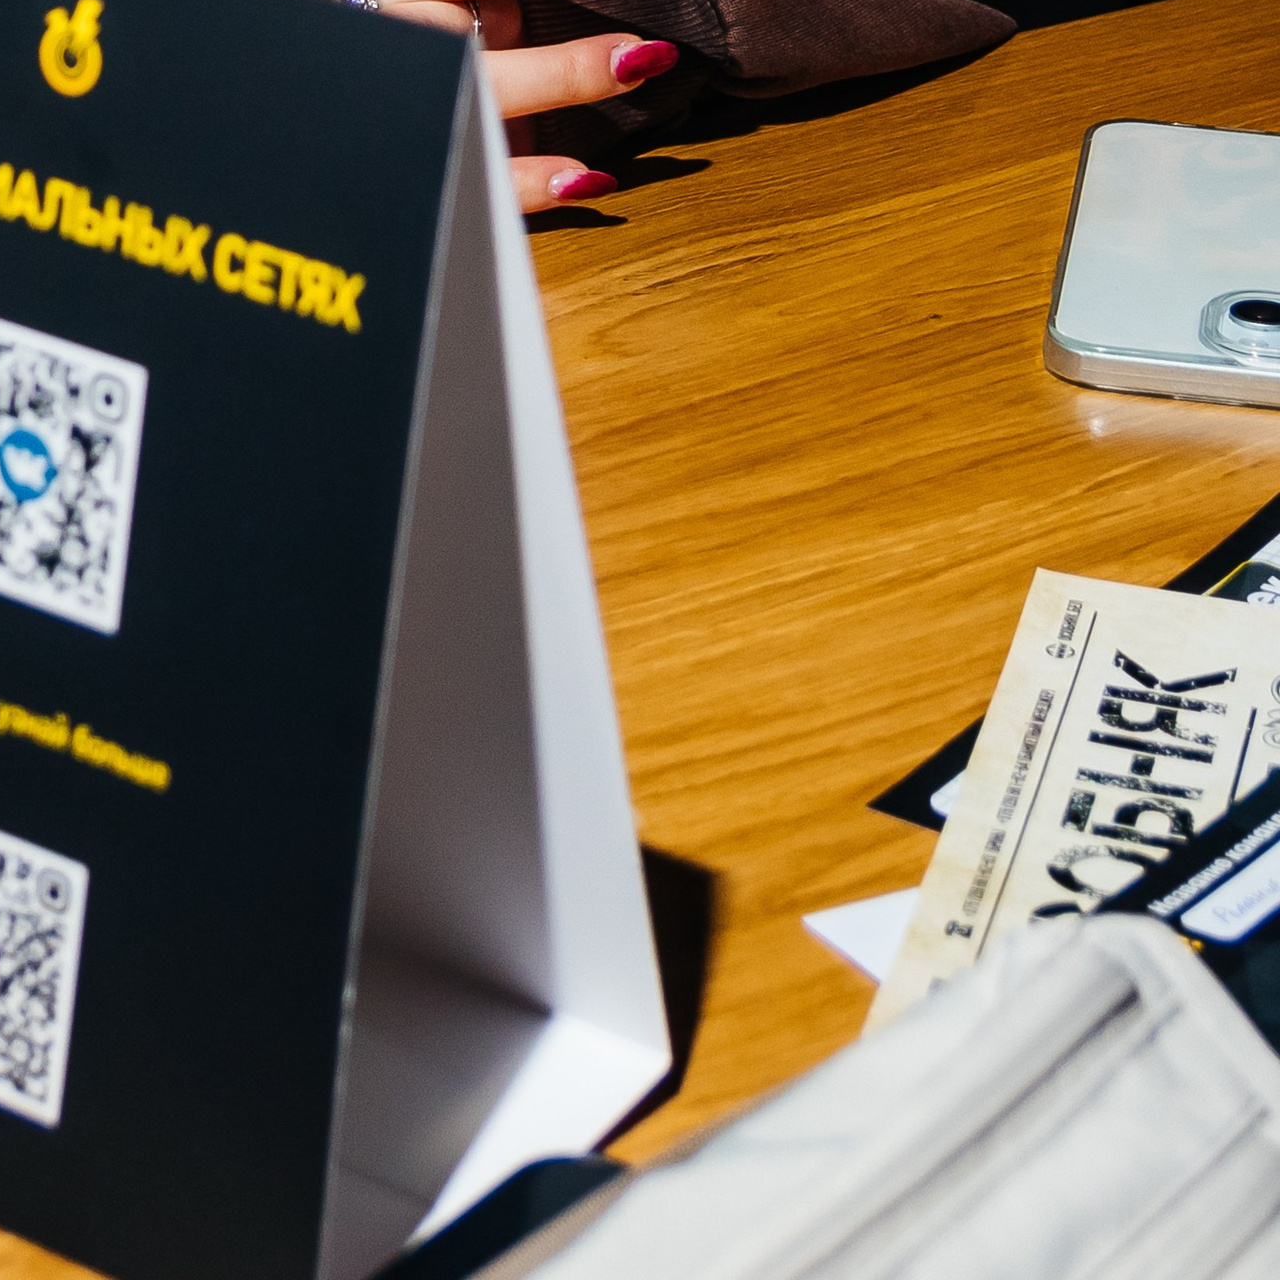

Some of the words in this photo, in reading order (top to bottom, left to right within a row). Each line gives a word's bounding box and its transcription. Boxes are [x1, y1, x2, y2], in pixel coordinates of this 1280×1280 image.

[213, 232, 367, 334] СЕТЯХ
[71, 723, 171, 792] больше
[1147, 856, 1233, 916] Название
